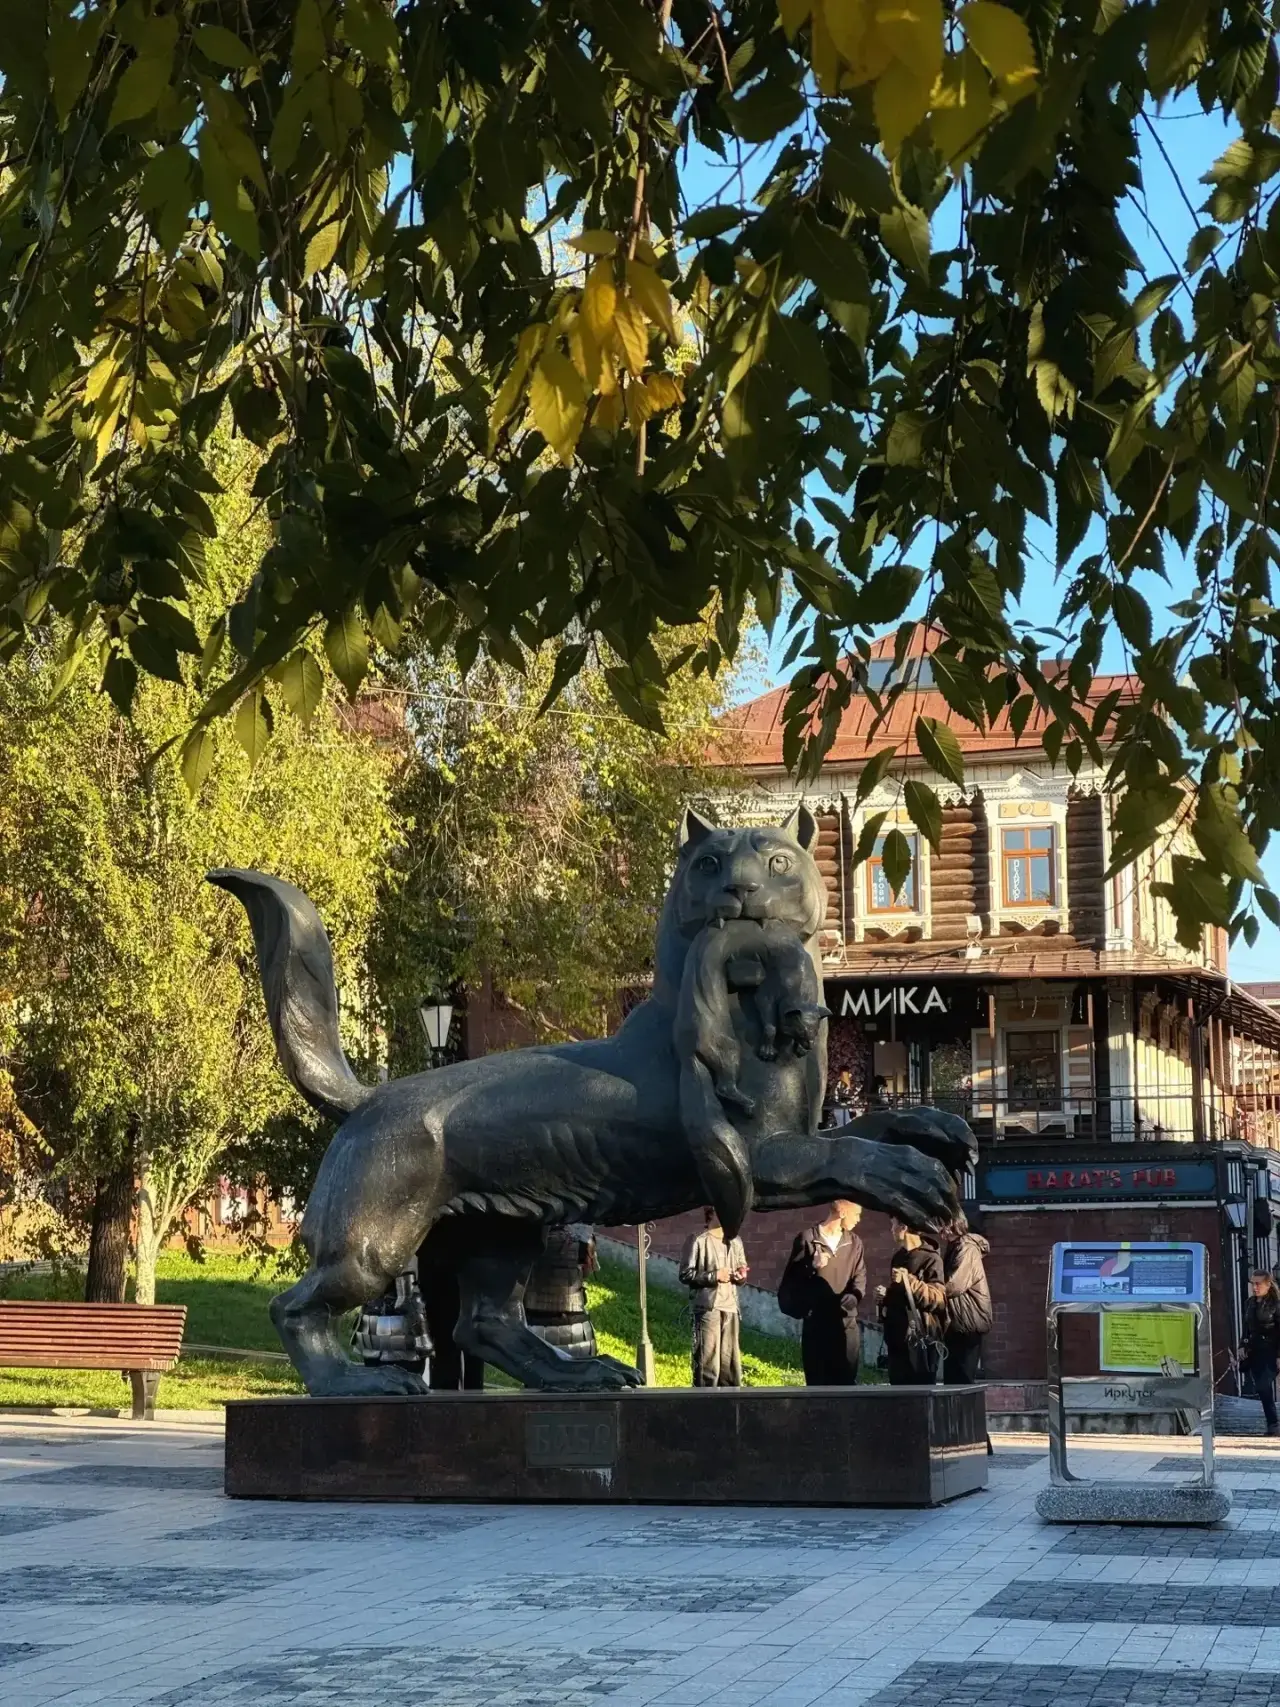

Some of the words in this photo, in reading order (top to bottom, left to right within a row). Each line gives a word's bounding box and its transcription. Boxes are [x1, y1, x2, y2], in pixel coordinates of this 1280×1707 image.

[840, 986, 948, 1016] МИКА
[1027, 1169, 1123, 1190] HARAT'S
[1133, 1168, 1178, 1188] PUB
[1104, 1387, 1156, 1402] Иркутск
